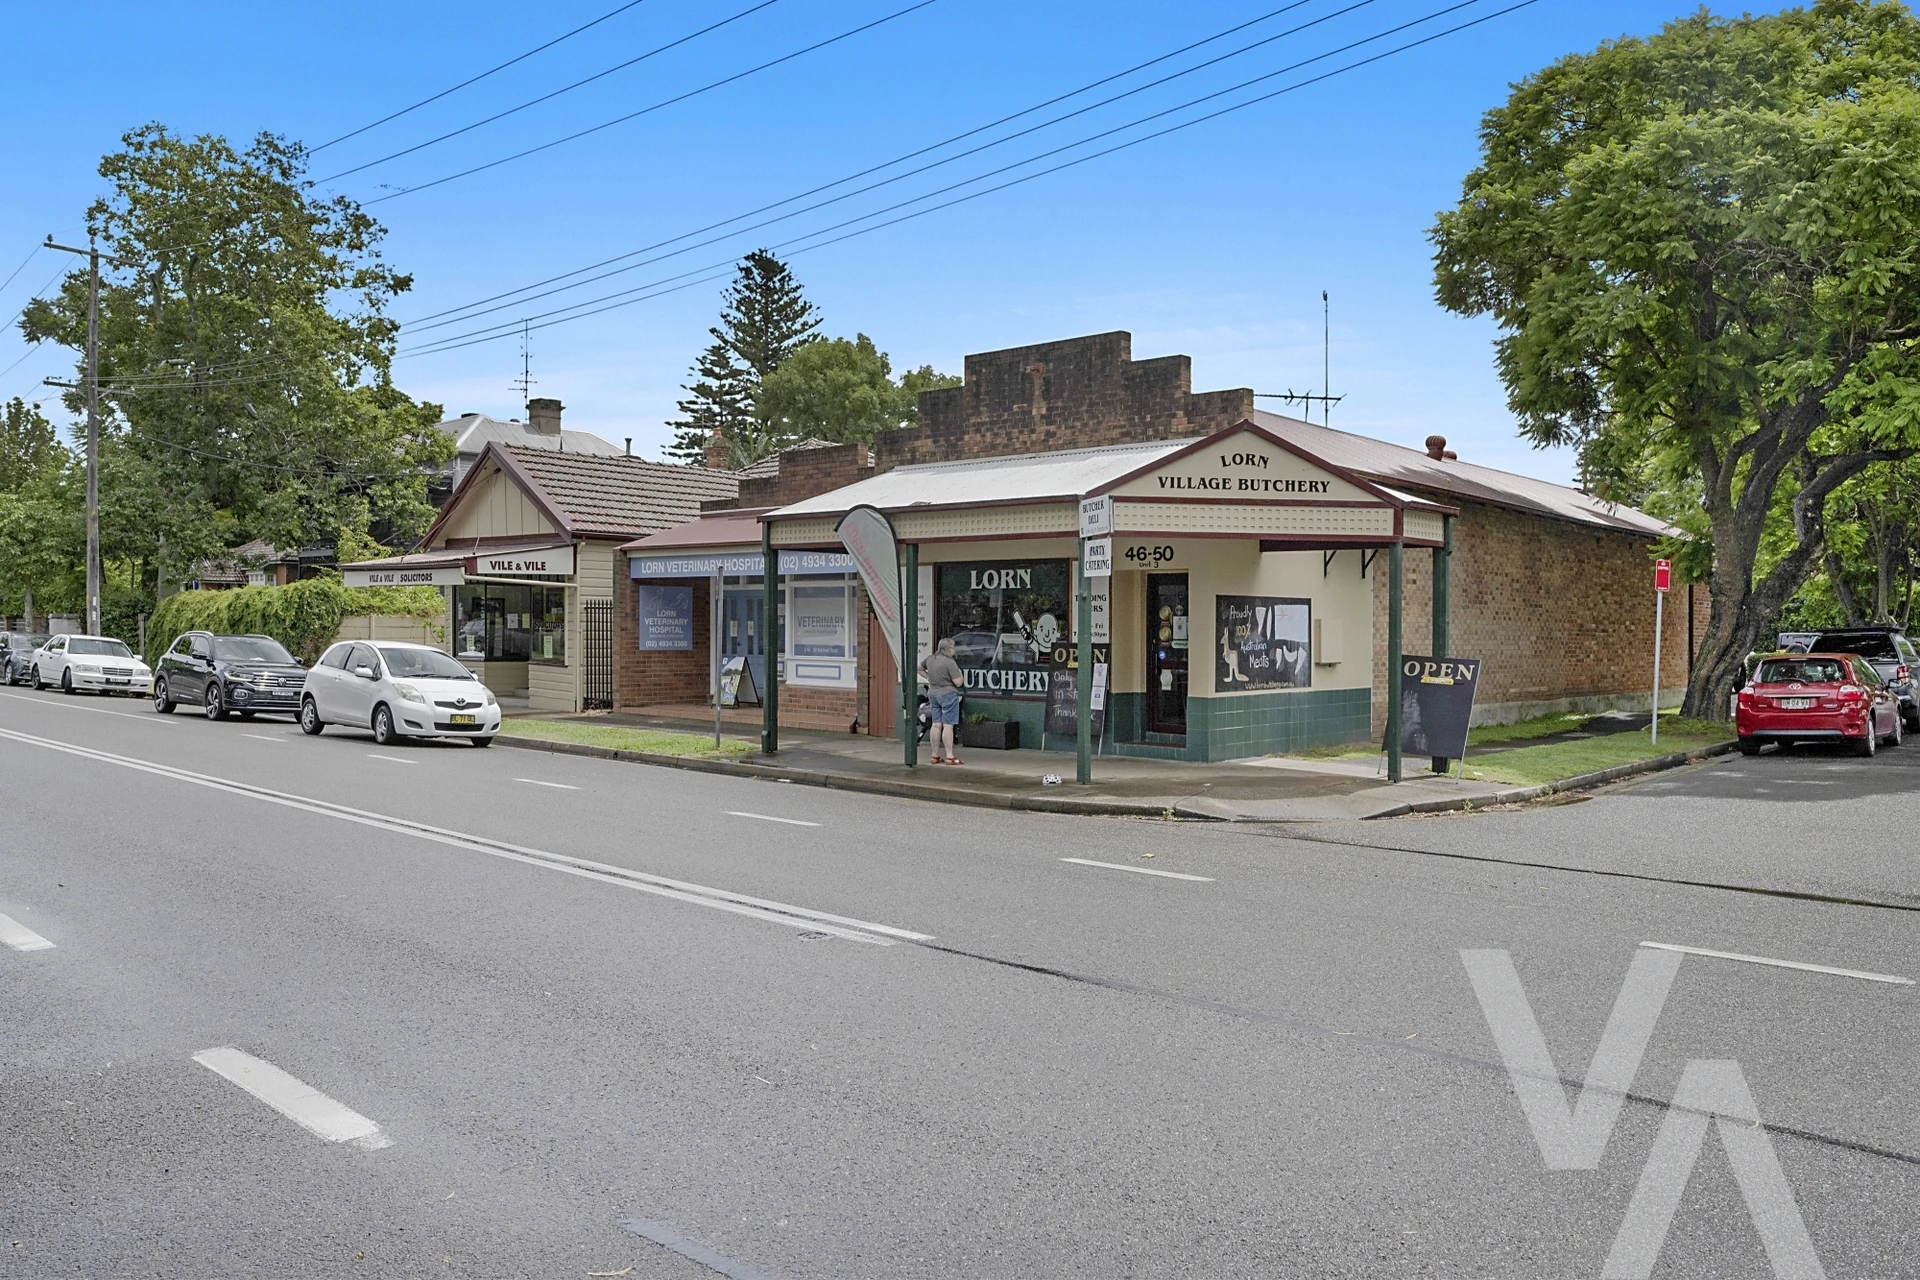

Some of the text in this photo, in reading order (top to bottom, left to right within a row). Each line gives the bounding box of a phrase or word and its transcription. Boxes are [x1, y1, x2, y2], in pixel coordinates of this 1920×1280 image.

[1220, 453, 1269, 469] LORN
[1158, 476, 1330, 493] VILLAGE BUTCHERY
[1082, 500, 1104, 514] BUTCHER
[1088, 514, 1099, 525] DELI
[1089, 545, 1105, 556] PARTY
[1125, 545, 1174, 561] 46-50
[489, 561, 513, 570] VILE
[524, 562, 546, 570] VILE
[641, 553, 854, 573] LORN VETERINARY HOSPITA (02) 4934 3300
[1085, 560, 1109, 571] CATERING
[369, 574, 379, 582] VILE
[384, 574, 395, 582] VILE
[400, 573, 433, 582] SOLICITORS
[970, 569, 1031, 589] LORN
[797, 616, 845, 628] VETERINARY
[649, 626, 684, 634] HOSPITAL
[1240, 640, 1267, 654] Australian
[1055, 647, 1106, 663] OPN
[1249, 652, 1269, 668] Meats
[1403, 661, 1475, 680] OPEN
[963, 669, 1048, 692] UTCHERY
